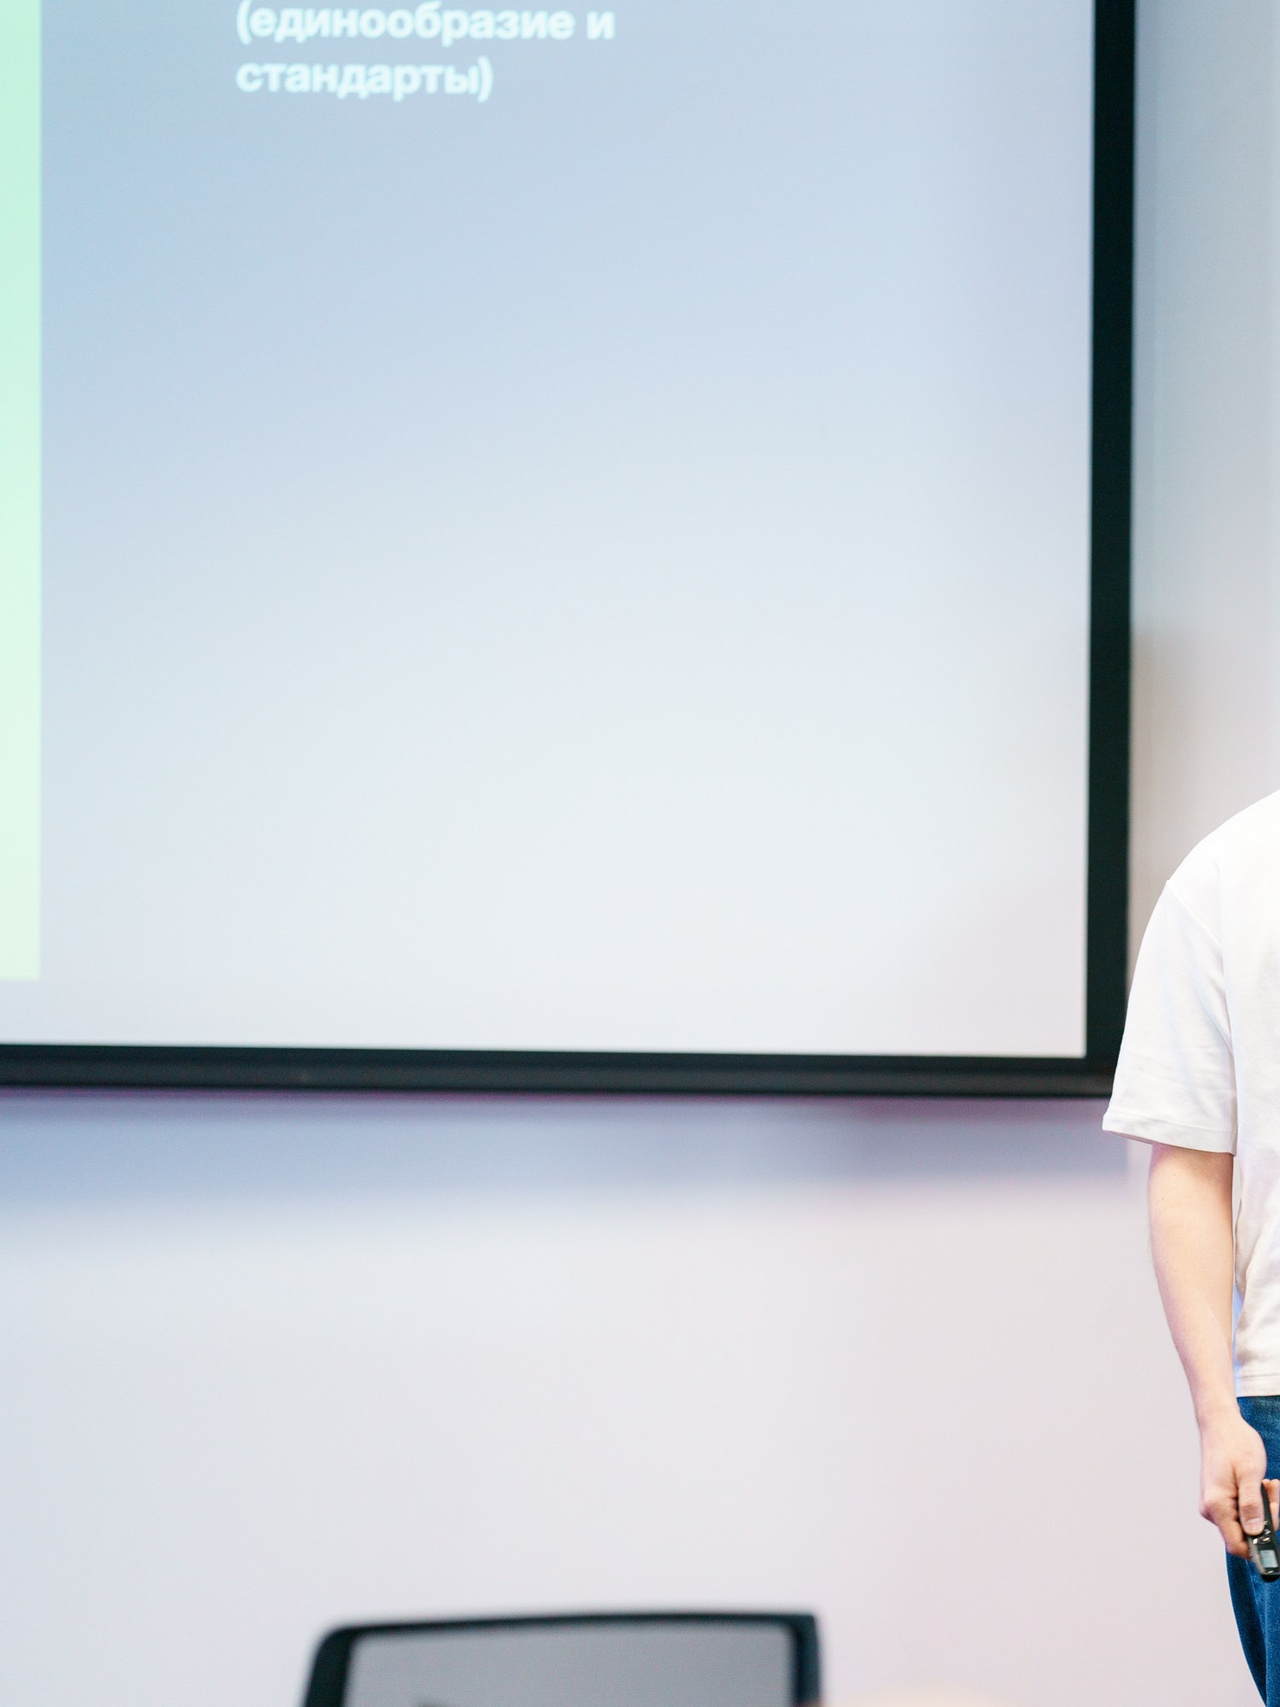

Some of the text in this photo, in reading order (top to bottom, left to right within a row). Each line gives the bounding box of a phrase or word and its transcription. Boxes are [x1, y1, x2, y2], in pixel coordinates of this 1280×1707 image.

[236, 0, 616, 47] (единообразие и
[235, 56, 493, 103] стандарты)
